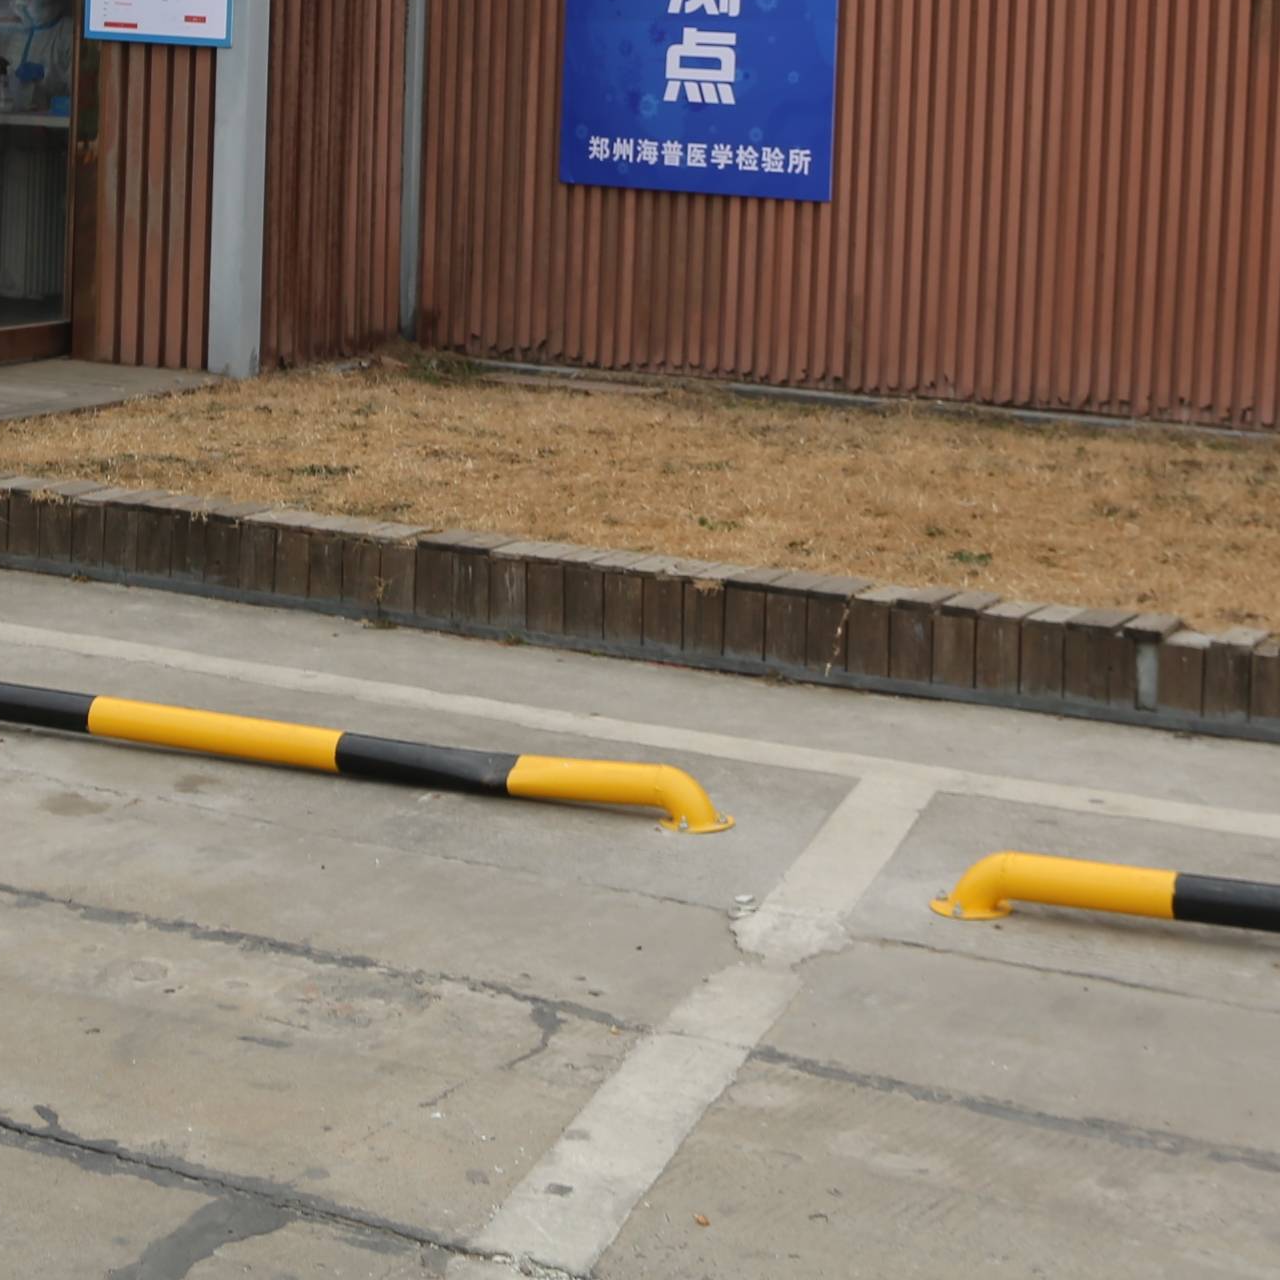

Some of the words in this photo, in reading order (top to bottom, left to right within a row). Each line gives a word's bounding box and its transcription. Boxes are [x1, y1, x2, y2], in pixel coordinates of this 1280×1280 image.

[588, 135, 812, 176] 郑州海普医学检验所
